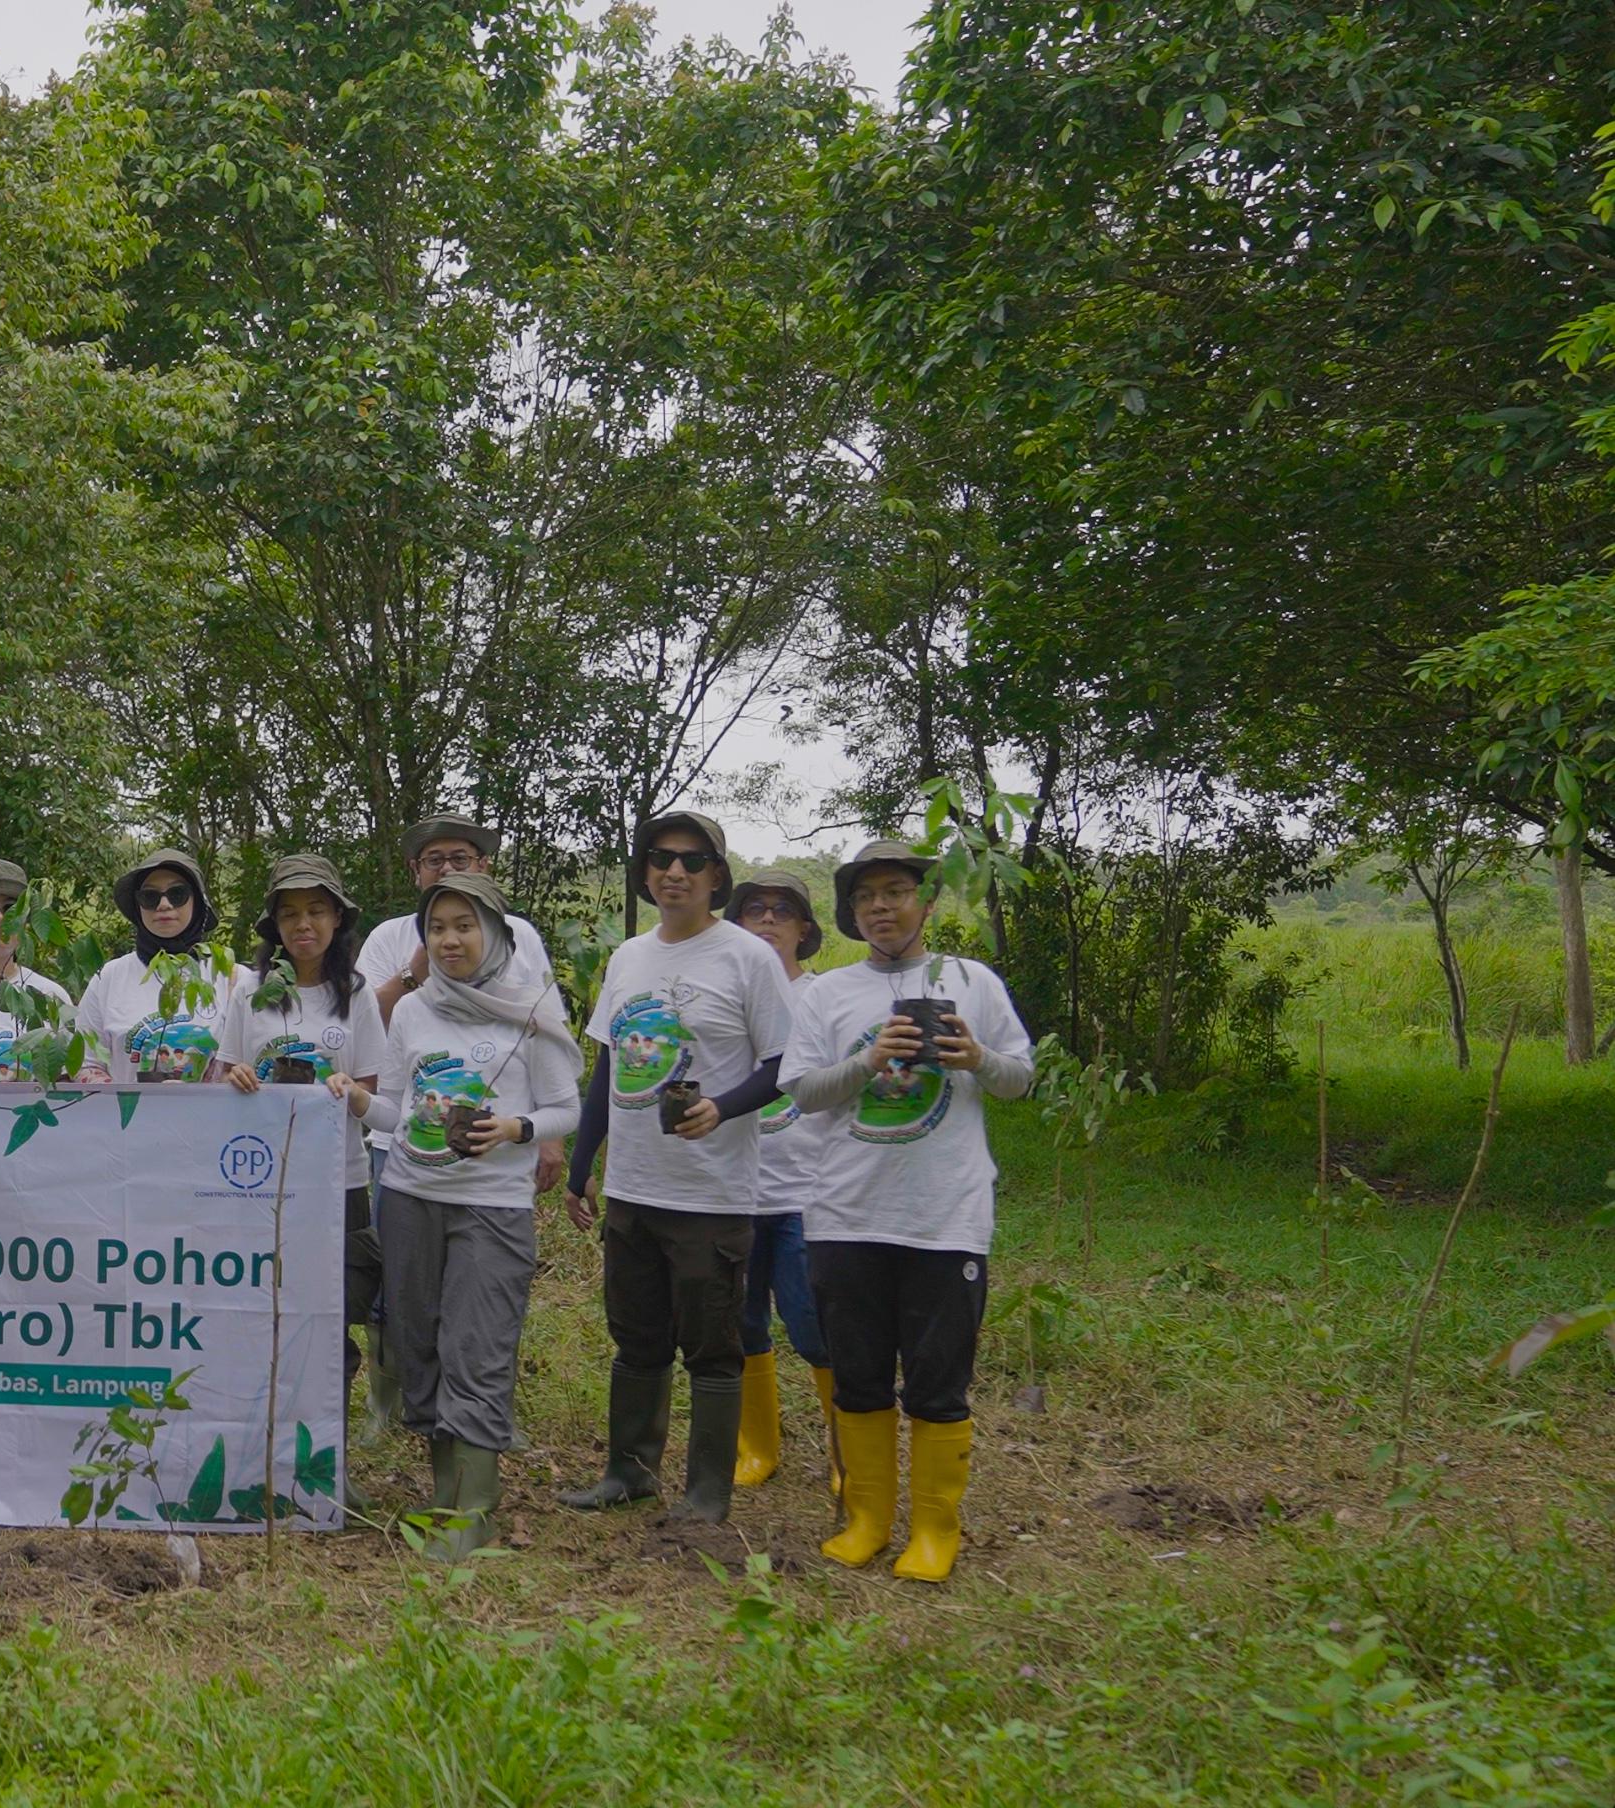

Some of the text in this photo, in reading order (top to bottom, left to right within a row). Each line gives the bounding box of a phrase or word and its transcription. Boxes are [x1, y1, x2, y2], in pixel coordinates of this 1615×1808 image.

[327, 1031, 343, 1044] PP
[475, 1046, 492, 1058] PP
[232, 1149, 265, 1175] PP
[96, 1237, 283, 1288] Pohon
[93, 1302, 204, 1352] Tbk
[53, 1375, 165, 1402] Lampung
